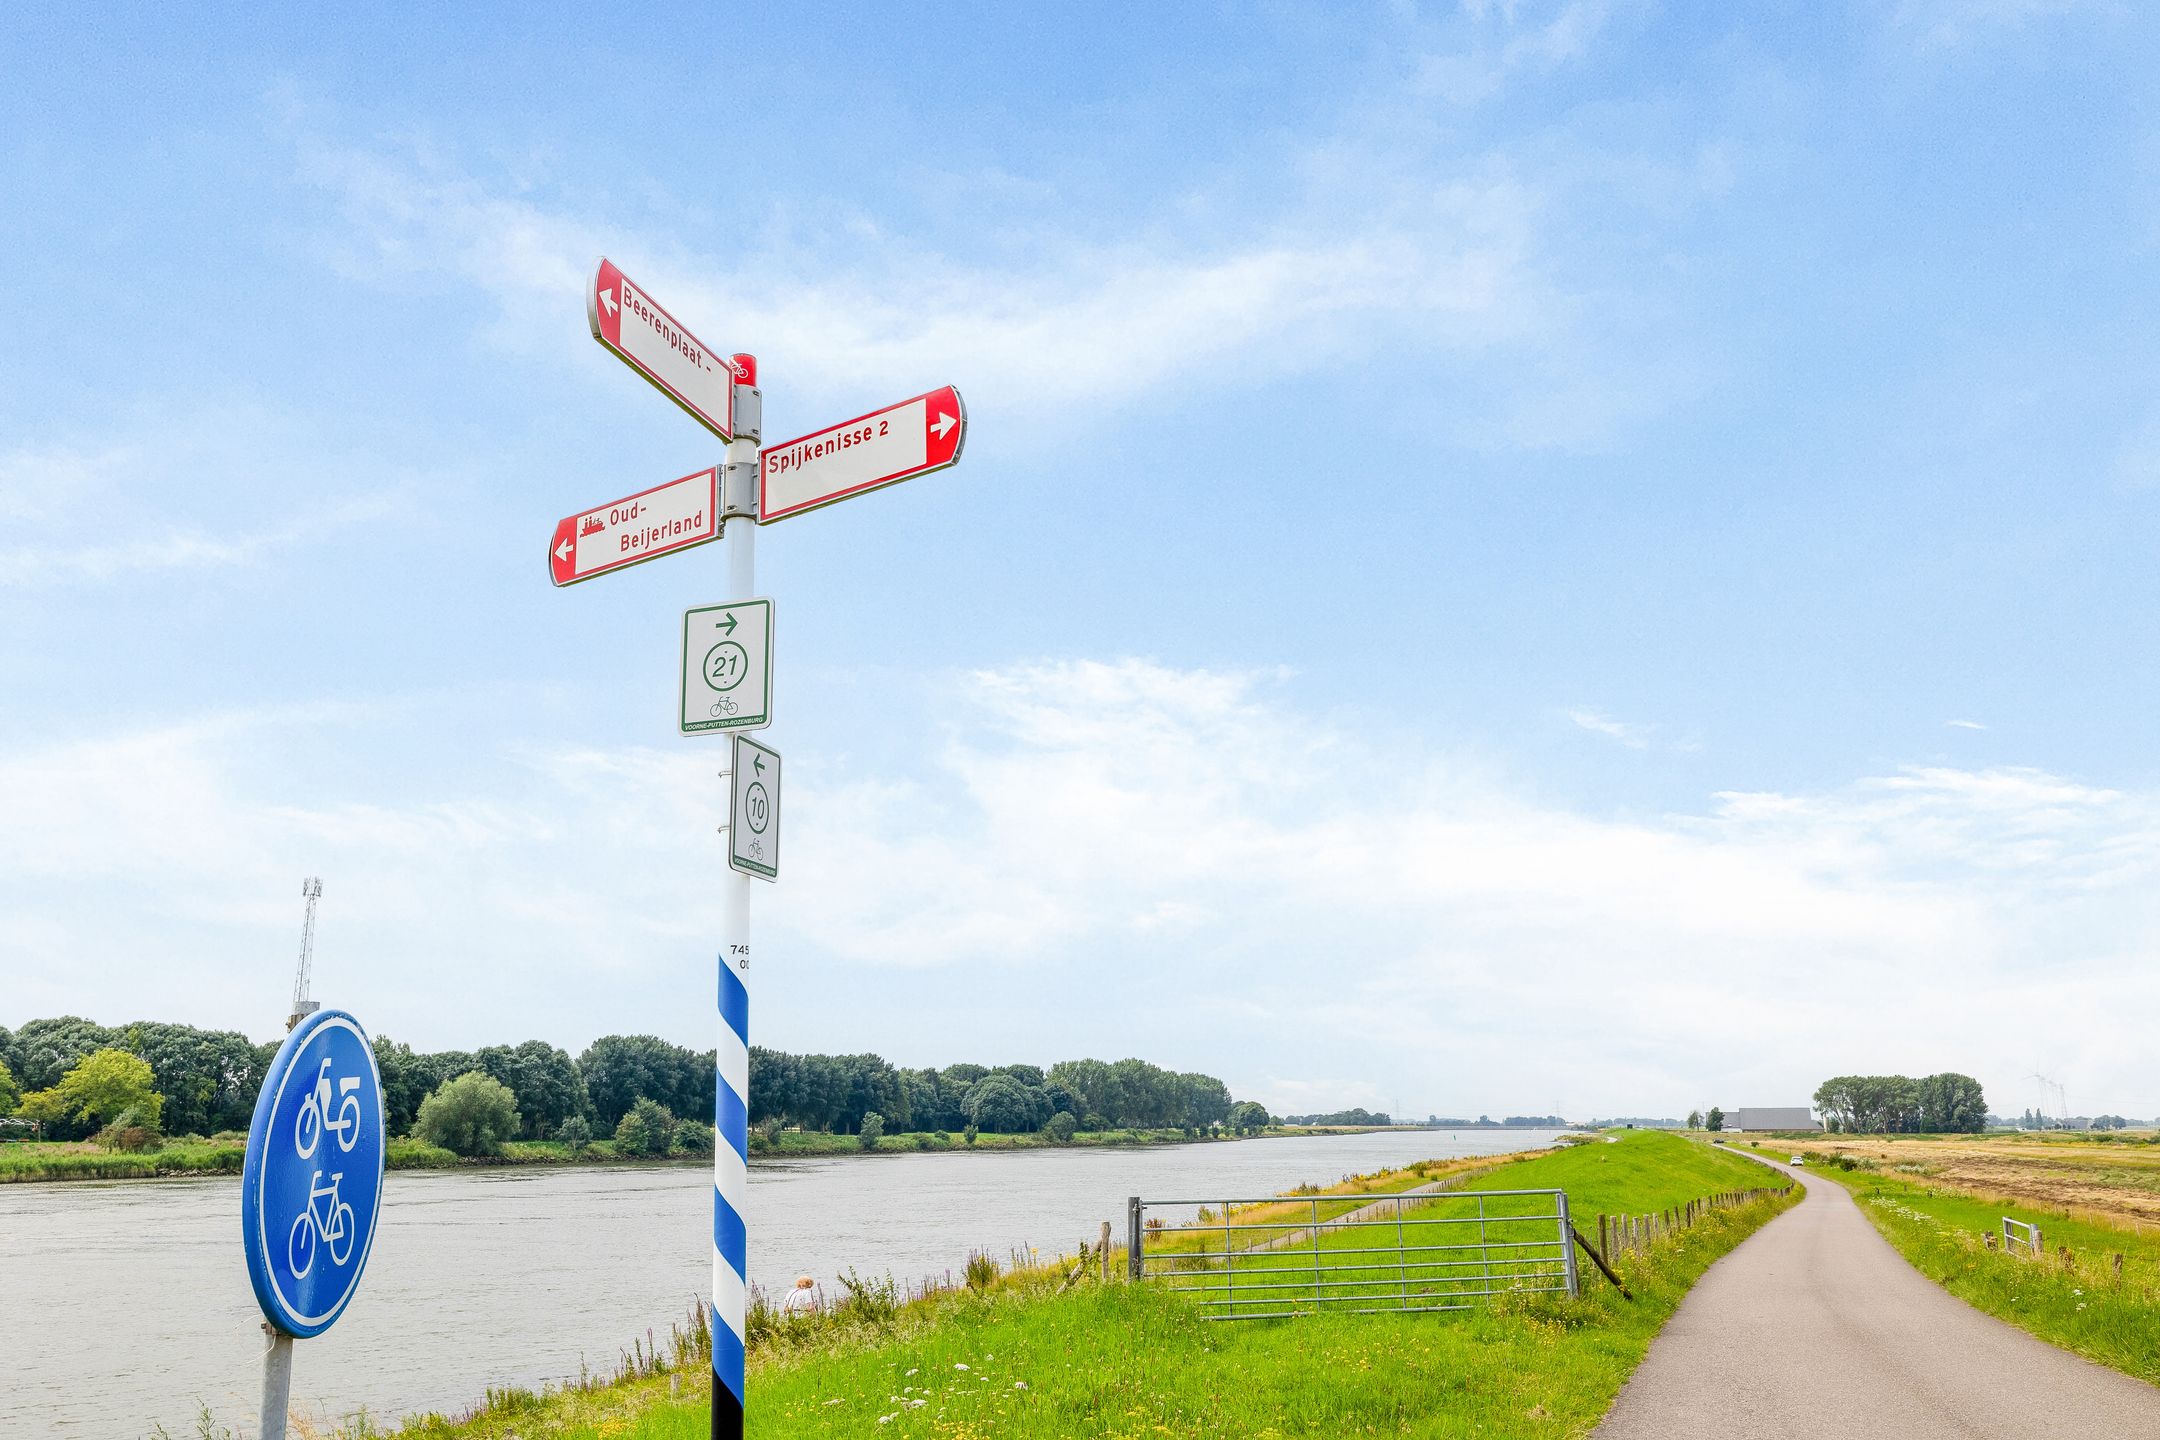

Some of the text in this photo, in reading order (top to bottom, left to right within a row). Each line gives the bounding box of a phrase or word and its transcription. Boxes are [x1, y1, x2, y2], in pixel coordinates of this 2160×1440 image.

[623, 285, 702, 369] Beerenplaat
[769, 420, 889, 474] Spijkenisse 2
[610, 501, 647, 526] Oud-
[620, 510, 702, 552] Beijerland
[712, 654, 738, 678] 21
[752, 797, 765, 820] 10
